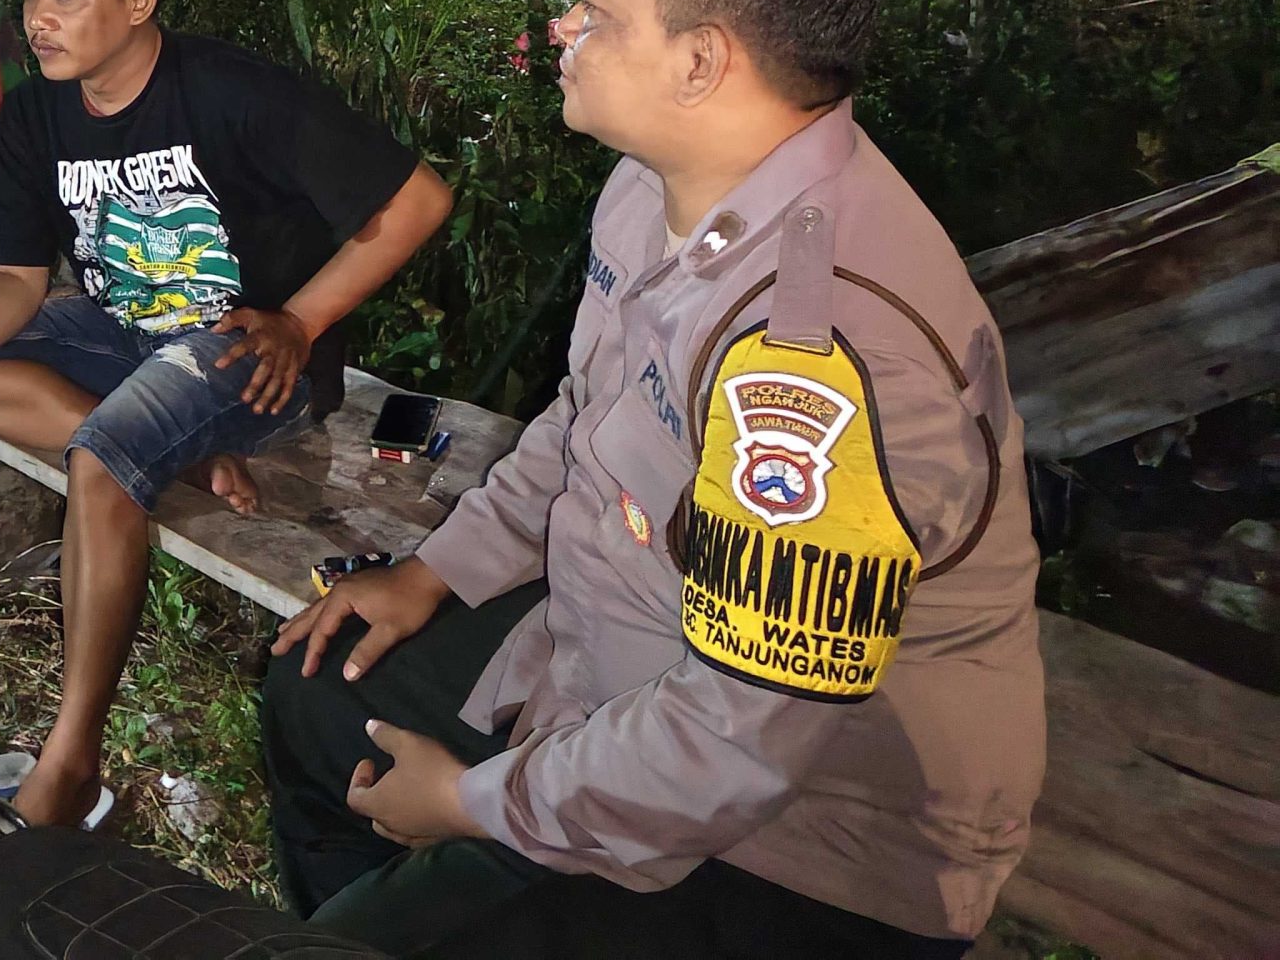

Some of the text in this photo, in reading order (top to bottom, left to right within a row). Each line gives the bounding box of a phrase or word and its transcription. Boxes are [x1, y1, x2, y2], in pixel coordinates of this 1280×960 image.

[57, 144, 220, 208] BONEK GRESIK
[741, 384, 837, 415] POLRES
[749, 394, 826, 418] NGANJUK
[750, 416, 784, 428] JAWA
[705, 621, 876, 684] TANJUNGANOM
[763, 620, 866, 661] WATES
